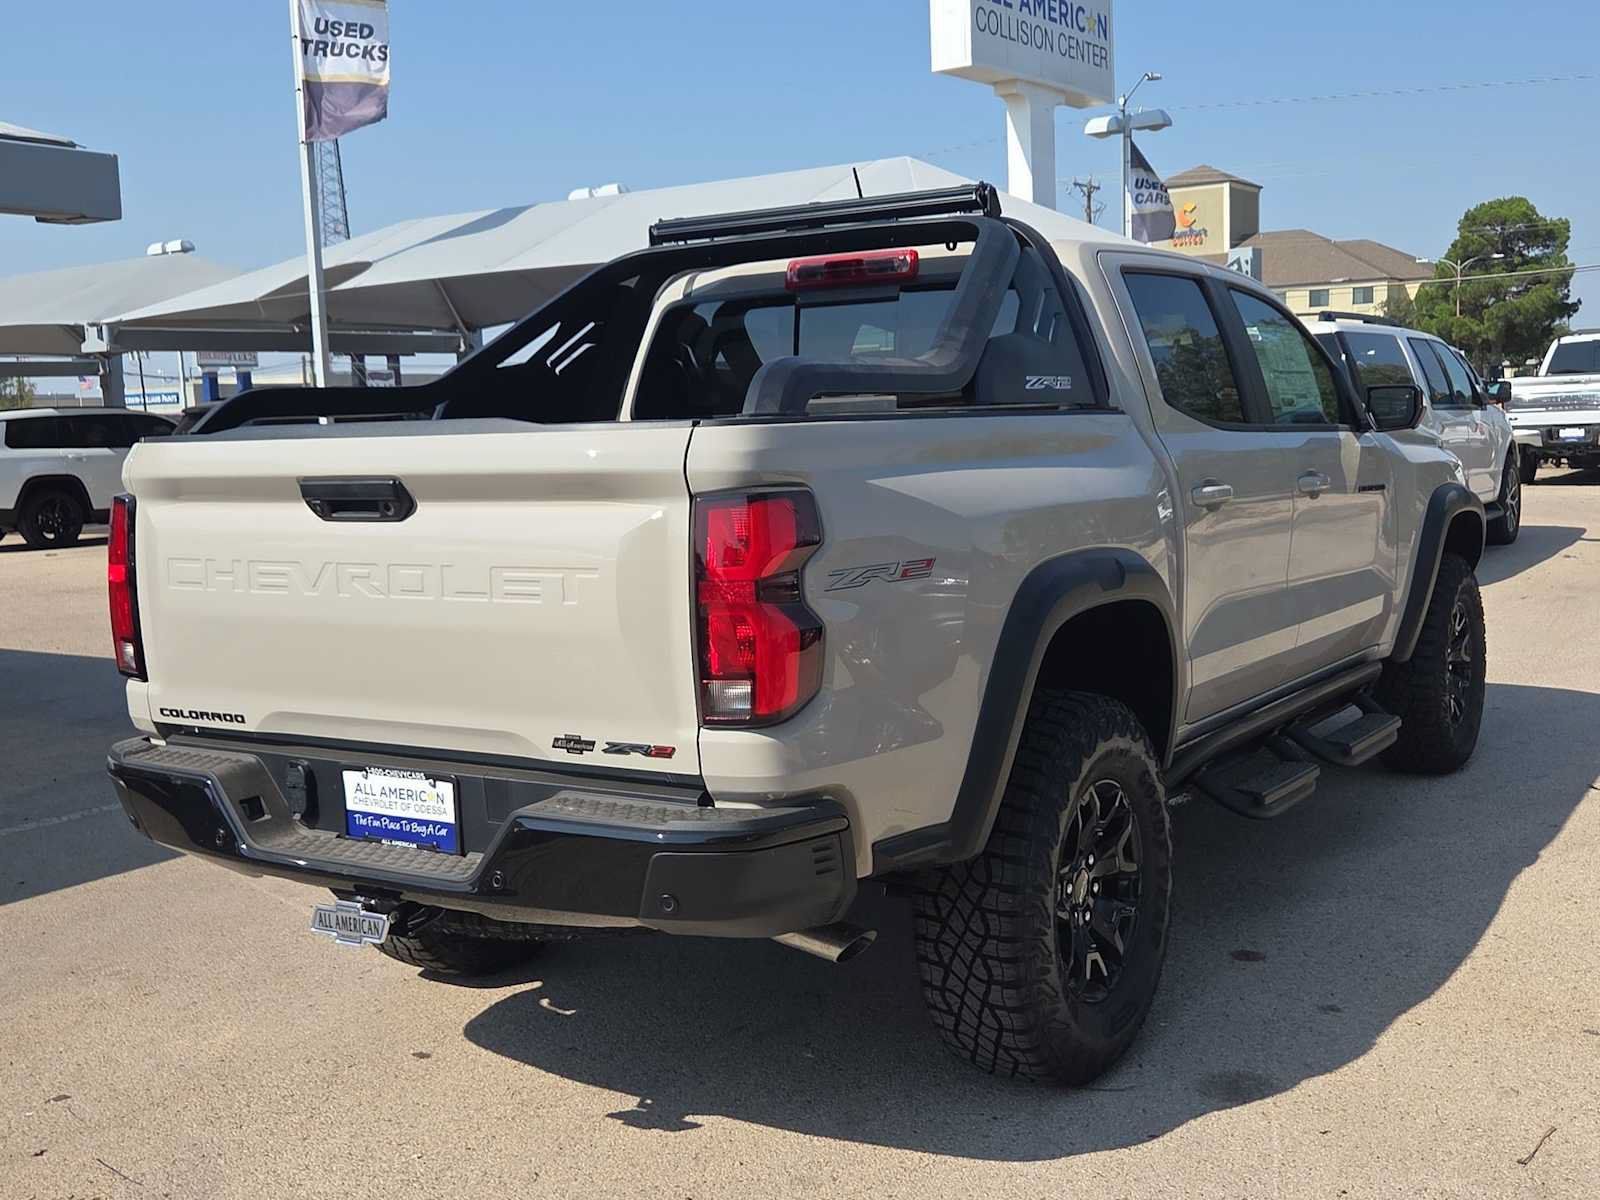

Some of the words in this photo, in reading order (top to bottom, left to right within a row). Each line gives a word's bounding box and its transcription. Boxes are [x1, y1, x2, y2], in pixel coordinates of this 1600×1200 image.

[314, 16, 375, 40] USED
[975, 6, 1054, 53] COLLISION
[1057, 31, 1109, 70] CENTER
[301, 38, 389, 62] TRUCKS
[1025, 375, 1072, 390] ZR2
[167, 556, 600, 606] CHEVROLET
[823, 556, 937, 592] ZR2
[159, 707, 247, 724] COLORADO
[601, 741, 676, 759] ZR2
[354, 782, 377, 797] ALL
[352, 796, 398, 811] CHEVROLET
[400, 802, 412, 813] OF
[413, 803, 448, 817] ODESSA
[353, 813, 367, 826] The
[381, 816, 401, 830] Place
[401, 820, 411, 833] To
[427, 823, 435, 835] A
[434, 825, 448, 837] Car
[318, 911, 334, 929] ALL
[335, 914, 380, 936] AMERICAN
